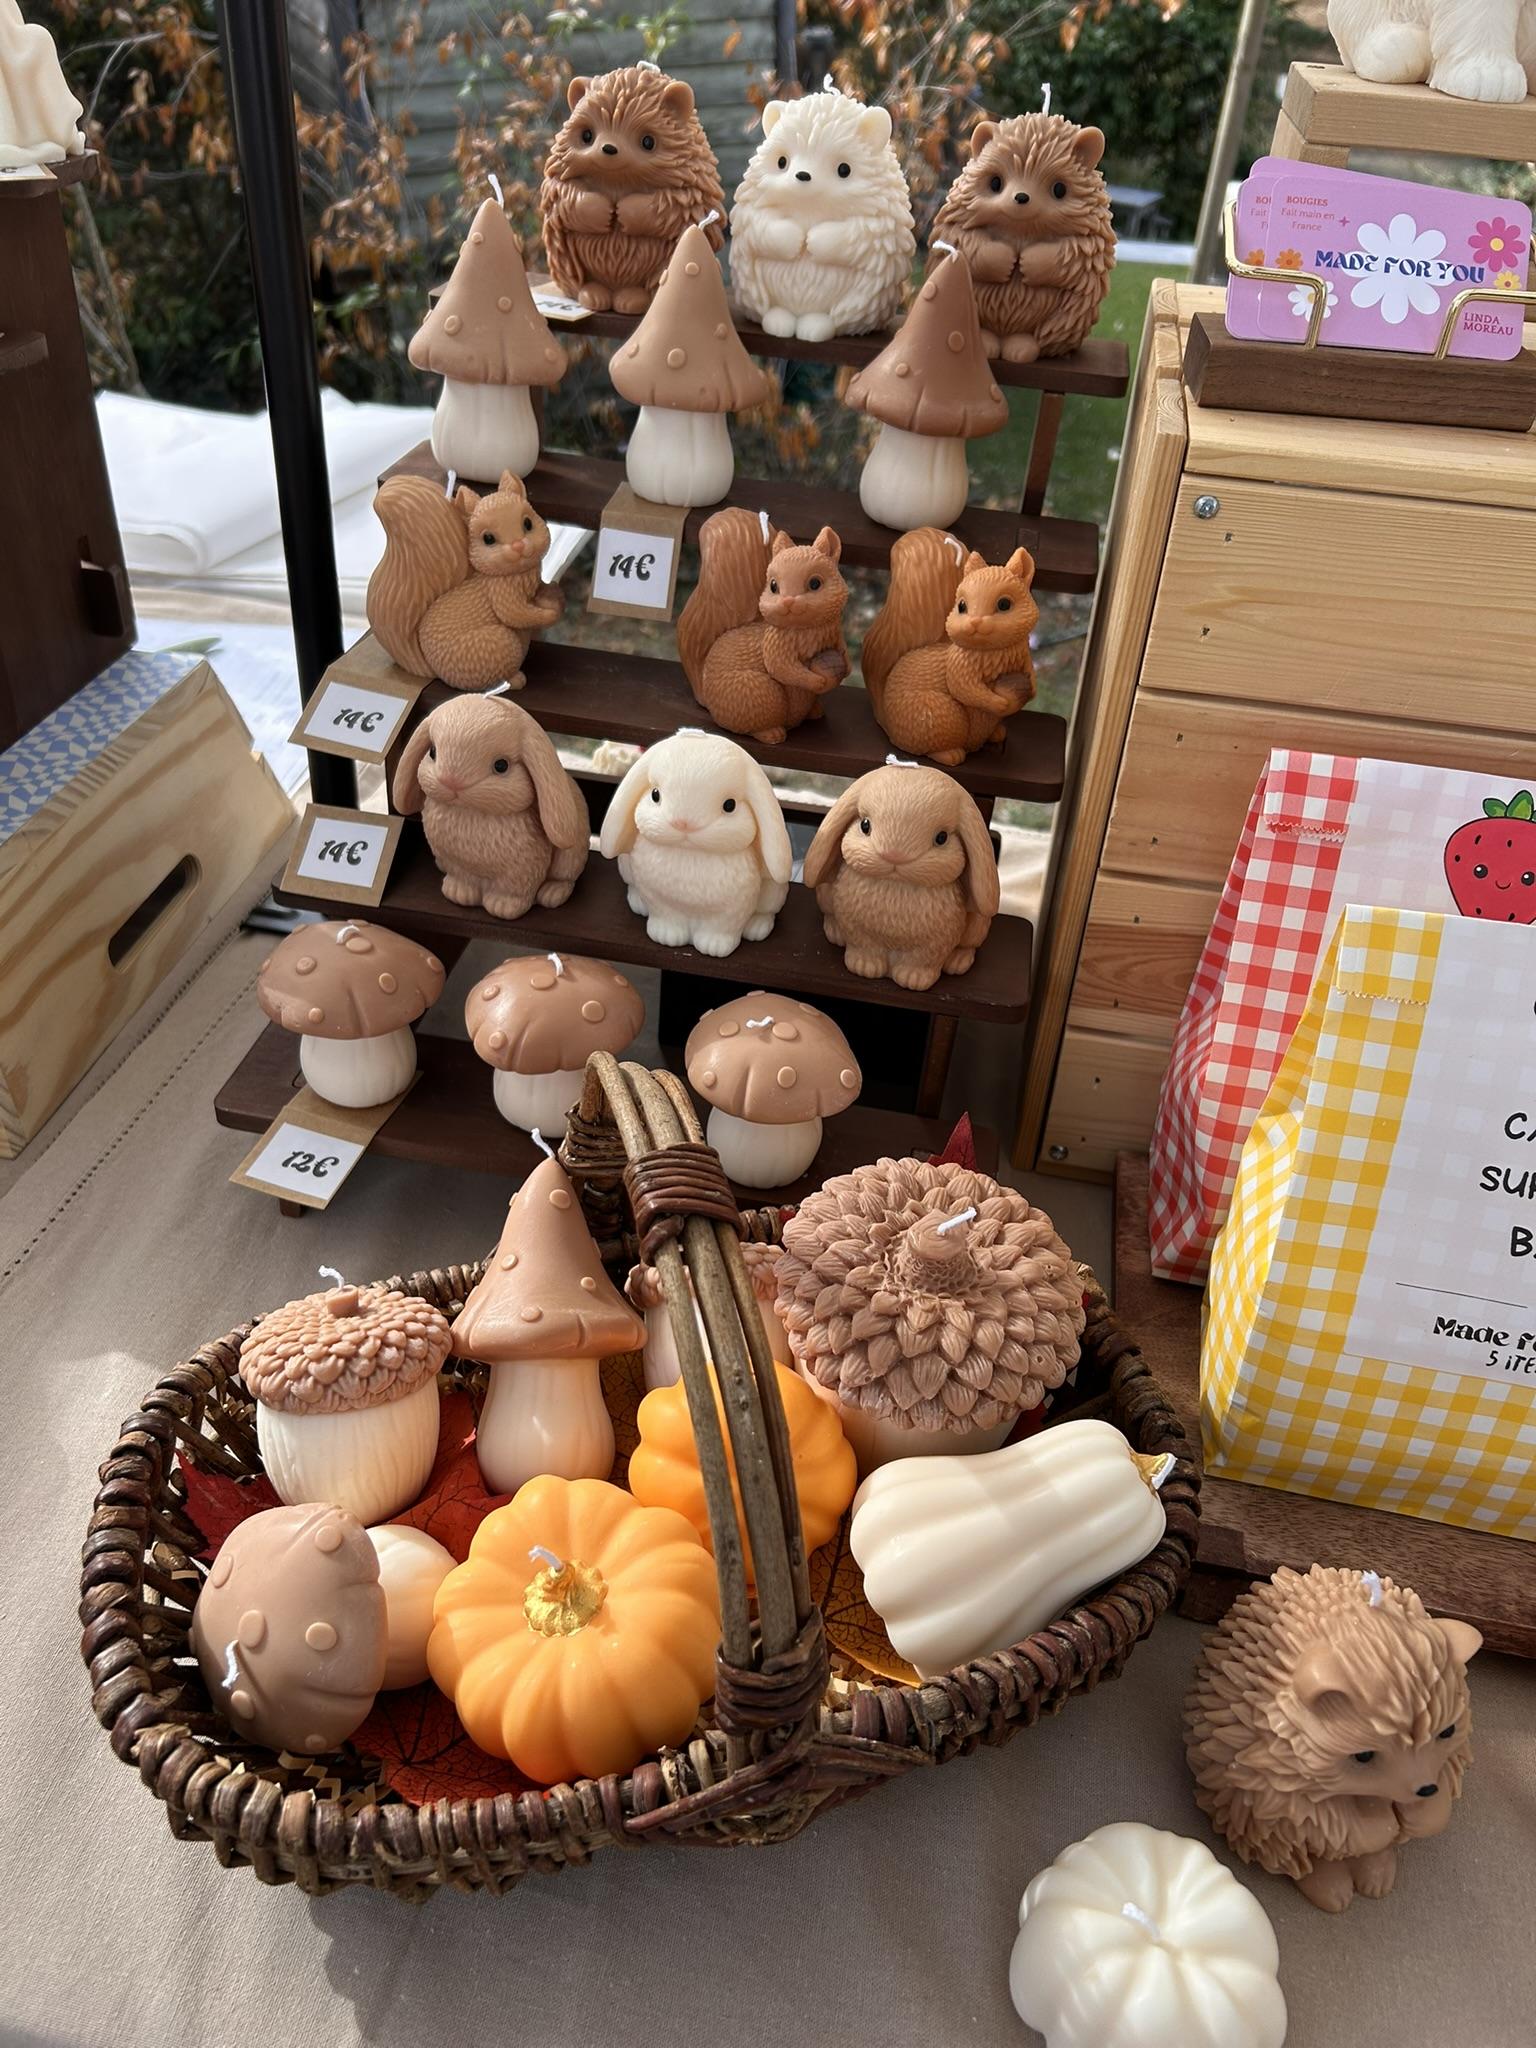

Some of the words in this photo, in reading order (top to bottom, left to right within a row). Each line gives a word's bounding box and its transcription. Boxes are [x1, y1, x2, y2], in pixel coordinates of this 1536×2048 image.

[1286, 195, 1328, 207] BOUGIES
[1281, 207, 1297, 217] Fait
[1299, 209, 1321, 219] main
[1291, 220, 1322, 231] France
[1315, 250, 1379, 272] MADE
[1384, 256, 1432, 278] FOR
[1436, 262, 1485, 283] YOU
[1463, 321, 1514, 336] MOREAU
[1464, 312, 1500, 325] LINDA
[609, 553, 656, 581] 14€
[333, 708, 384, 733] 14€
[318, 840, 368, 866] 14€
[281, 1151, 340, 1178] 12€
[1433, 1316, 1510, 1347] Made
[1485, 1350, 1499, 1367] 5
